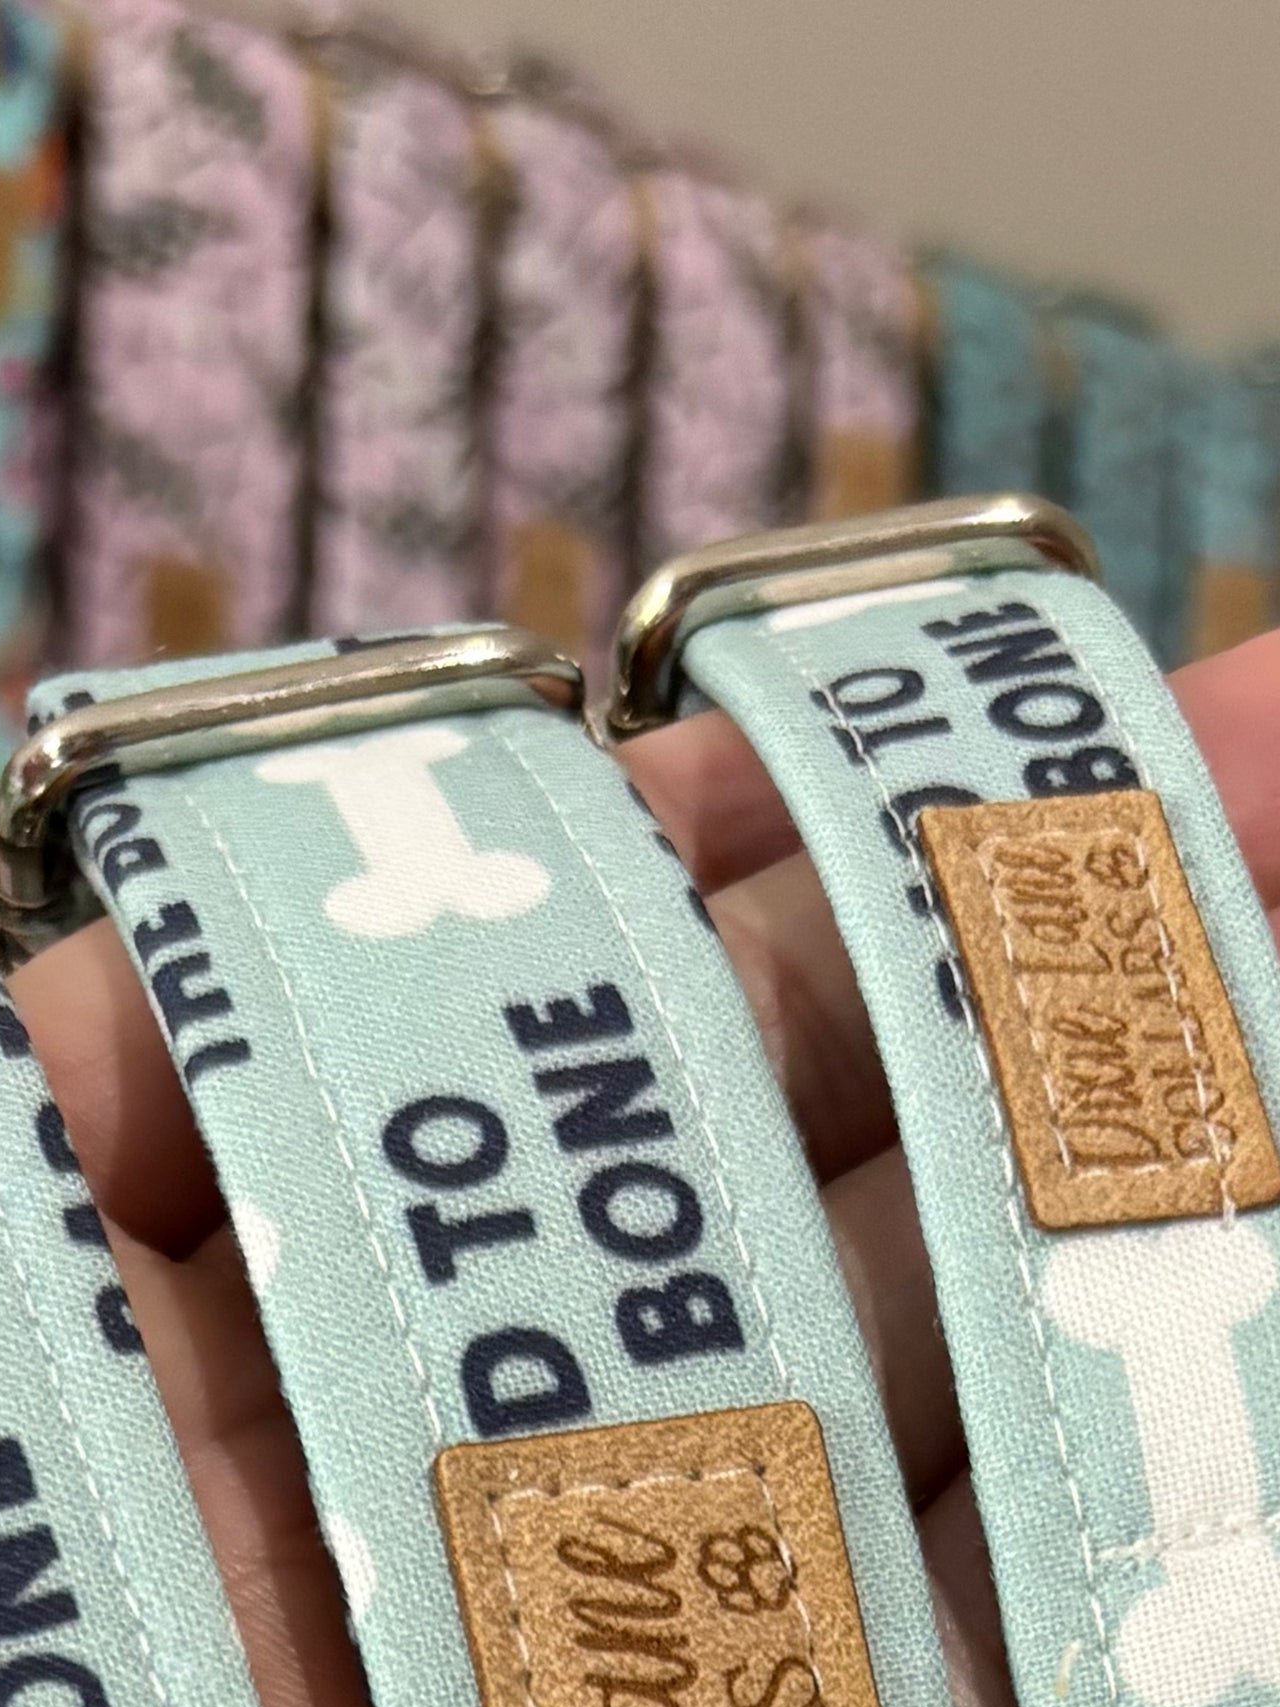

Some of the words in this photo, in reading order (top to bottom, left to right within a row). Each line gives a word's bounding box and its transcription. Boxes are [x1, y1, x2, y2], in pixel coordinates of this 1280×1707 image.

[810, 667, 954, 766] TO
[921, 602, 1141, 798] BONE
[380, 1094, 537, 1286] TO
[506, 981, 746, 1366] BONE
